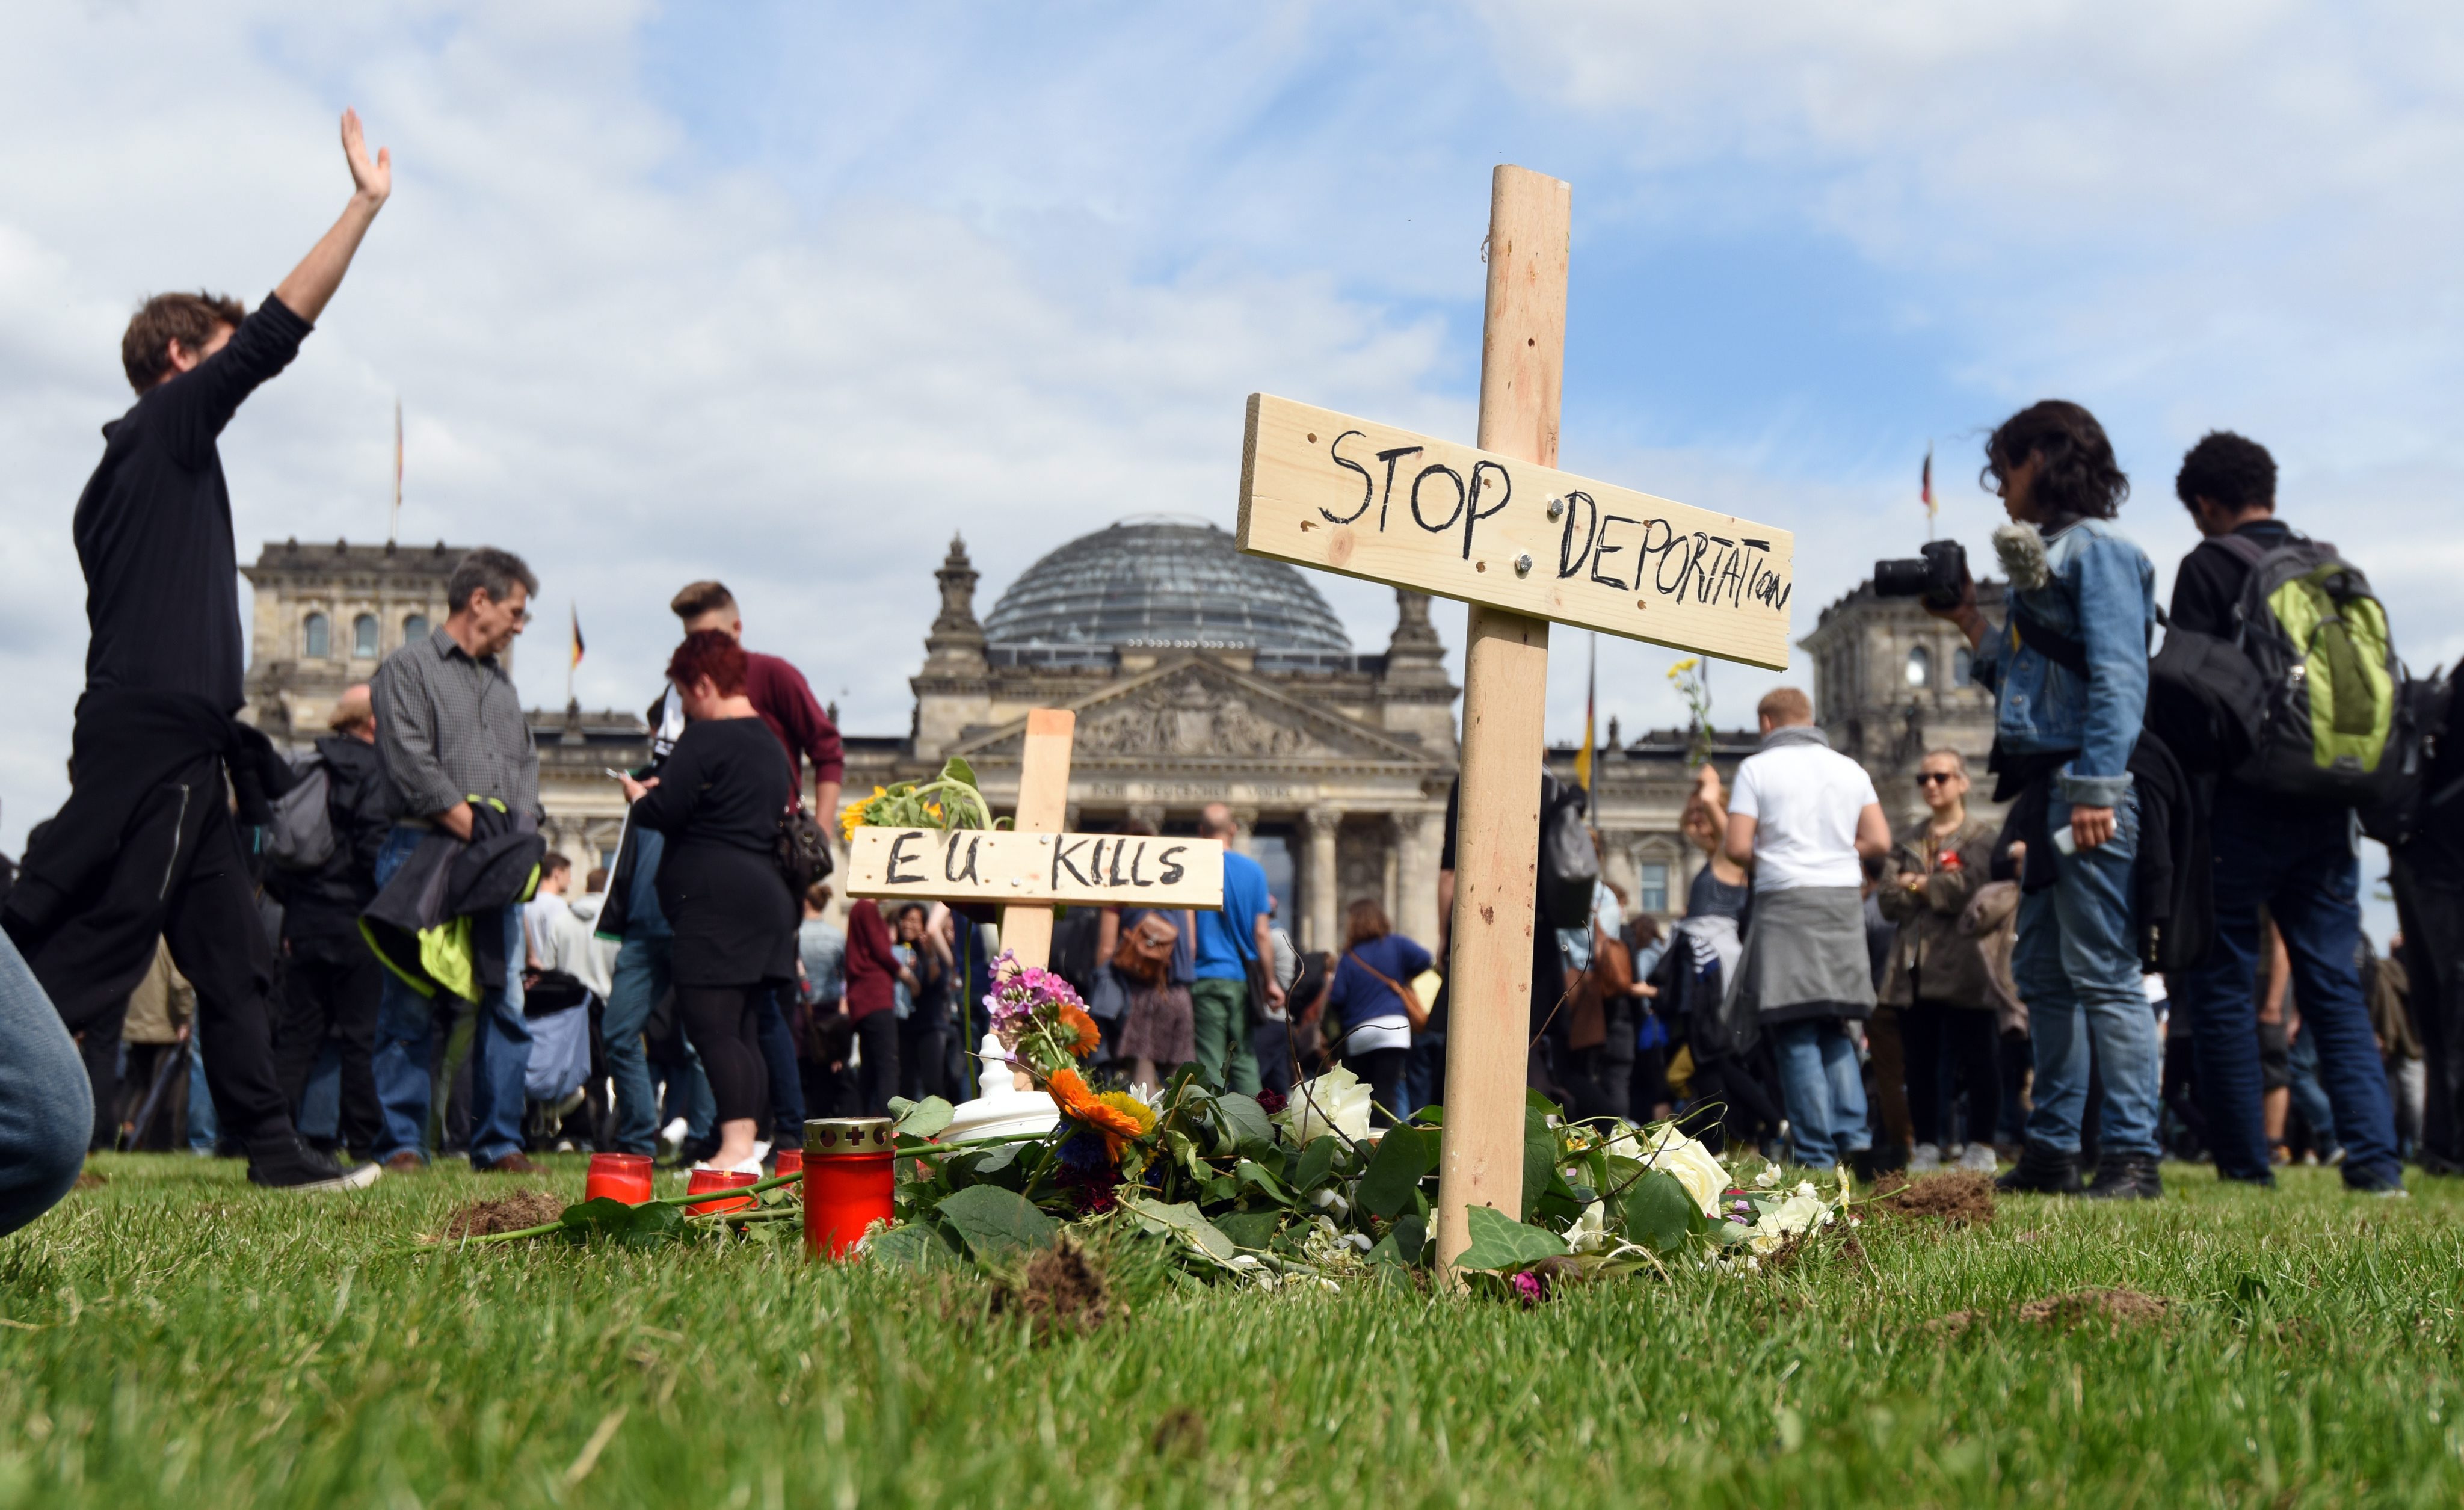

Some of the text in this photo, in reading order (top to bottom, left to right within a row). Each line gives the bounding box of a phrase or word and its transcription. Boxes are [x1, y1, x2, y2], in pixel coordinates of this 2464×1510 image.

[1319, 430, 1512, 561] STOP
[886, 831, 1189, 890] EU KILLS
